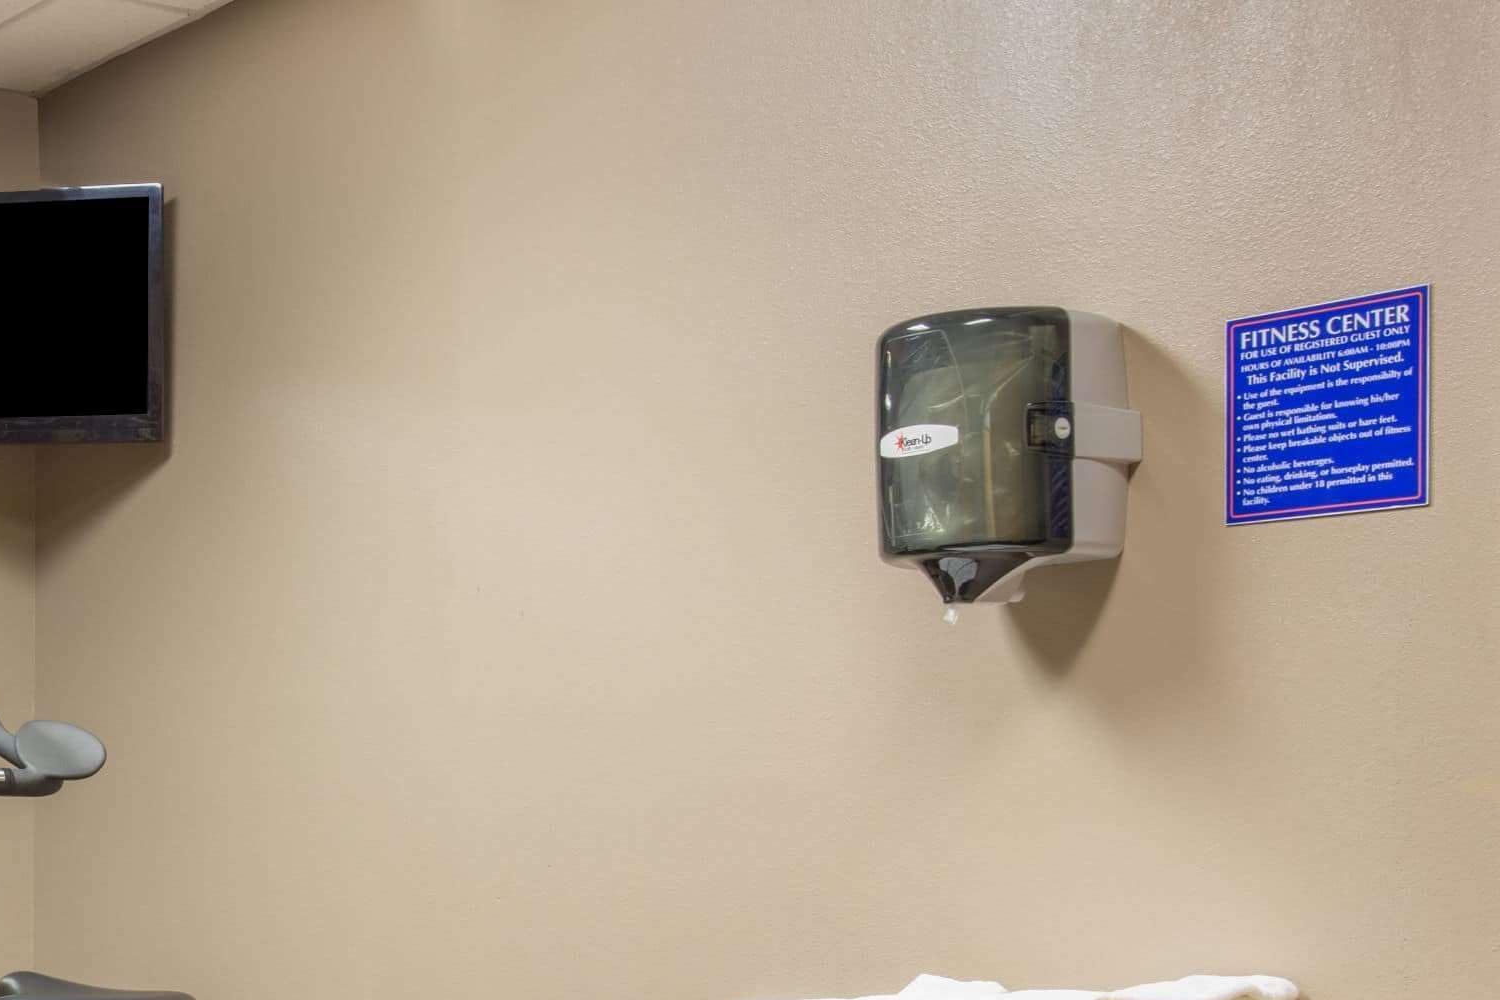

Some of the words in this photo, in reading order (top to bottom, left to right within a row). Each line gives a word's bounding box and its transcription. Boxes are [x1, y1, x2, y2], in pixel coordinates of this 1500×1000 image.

[1241, 319, 1321, 349] FITNESS
[1326, 304, 1410, 335] CENTER
[1240, 350, 1258, 360] FOR
[1261, 347, 1277, 357] USE
[1279, 344, 1293, 354] OF
[1294, 337, 1348, 352] REGISTERED
[1350, 330, 1380, 342] GUEST
[1383, 325, 1410, 337] ONLY
[1240, 361, 1269, 373] HOURS
[1271, 359, 1282, 368] OF
[1283, 350, 1336, 366] AVAILABILITY
[1247, 374, 1268, 386] This
[1269, 367, 1307, 382] Facility
[1309, 365, 1318, 376] is
[1320, 363, 1341, 374] Not
[1343, 352, 1404, 372] Supervised.
[1244, 392, 1259, 400] Use
[1260, 389, 1268, 398] of
[1269, 387, 1282, 396] the
[1284, 381, 1325, 395] equipment
[1327, 379, 1334, 388] is
[1335, 378, 1348, 386] the
[1404, 366, 1413, 376] of
[1243, 401, 1255, 410] the
[1257, 399, 1279, 410] guest.
[1244, 411, 1266, 421] Guest
[1276, 403, 1319, 417] responsible
[1321, 401, 1333, 410] for
[1334, 396, 1369, 408] knowing
[1370, 392, 1400, 403] his/her
[1243, 423, 1260, 431] own
[1261, 417, 1292, 431] physical
[1294, 412, 1338, 424] limitations.
[1243, 433, 1267, 441] Please
[1296, 424, 1327, 435] bathing
[1328, 421, 1346, 430] suits
[1359, 418, 1378, 426] bare
[1379, 414, 1398, 424] feet.
[1243, 444, 1267, 453] Please
[1268, 442, 1287, 451] keep
[1288, 436, 1327, 448] breakable
[1328, 432, 1357, 442] objects
[1359, 430, 1373, 439] out
[1374, 426, 1383, 436] of
[1385, 426, 1412, 435] fitness
[1243, 454, 1269, 463] center.
[1256, 461, 1292, 472] alcoholic
[1293, 458, 1335, 468] beverages.
[1331, 463, 1370, 475] horseplay
[1371, 457, 1415, 472] permitted.
[1257, 485, 1289, 495] children
[1289, 481, 1313, 491] under
[1326, 474, 1366, 489] permitted
[1367, 473, 1376, 482] in
[1378, 471, 1393, 481] this
[1243, 496, 1270, 506] facility.
